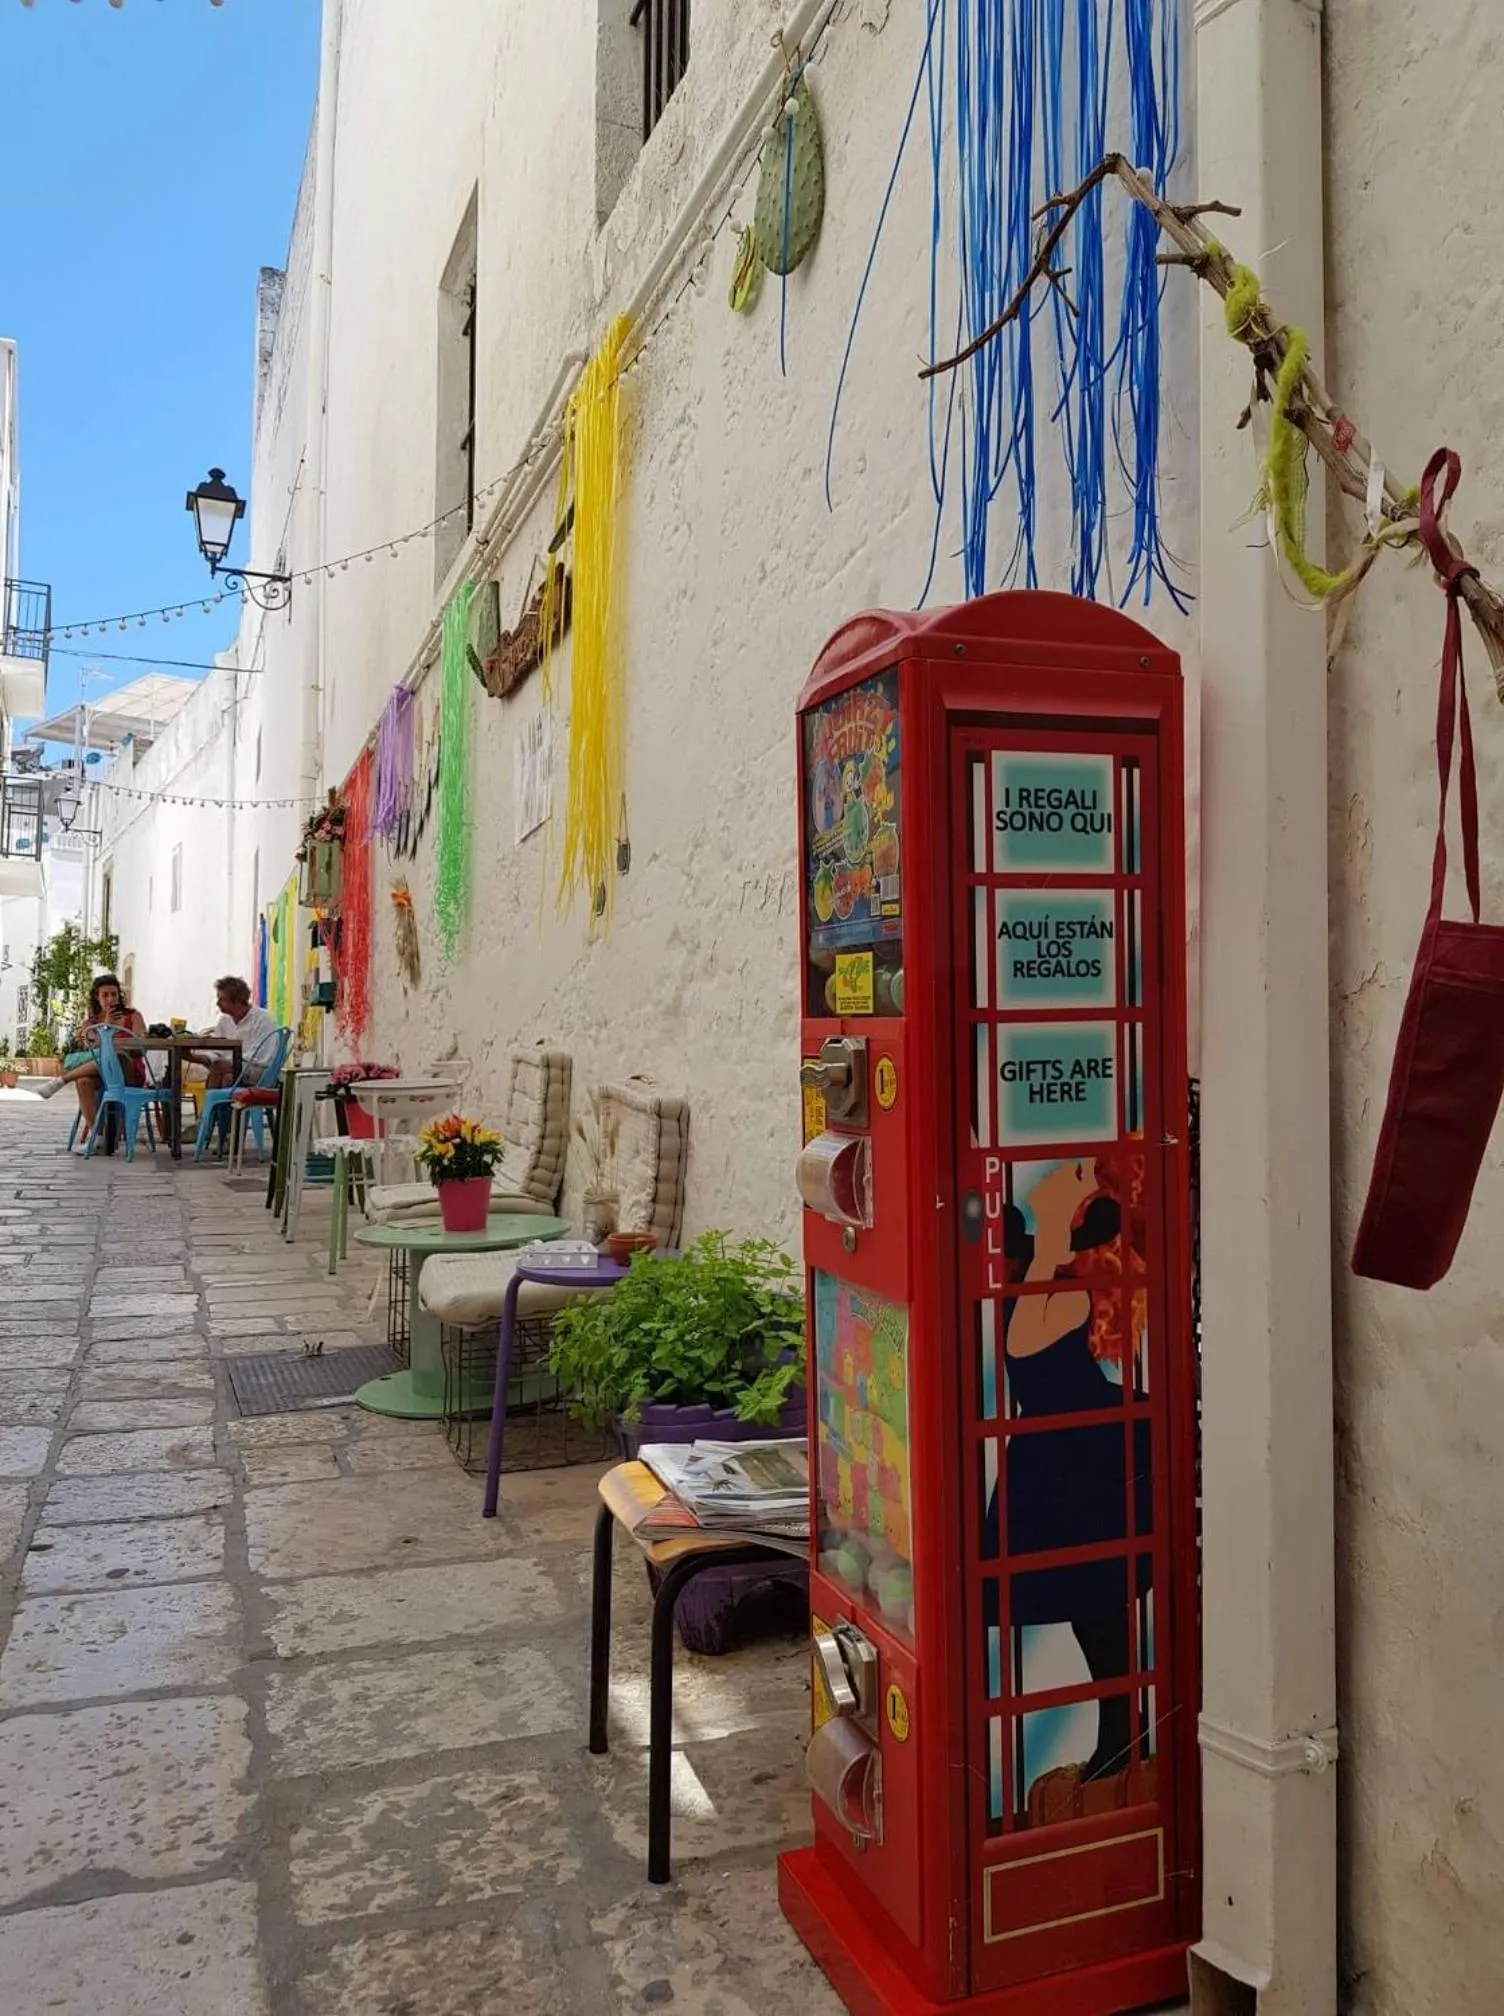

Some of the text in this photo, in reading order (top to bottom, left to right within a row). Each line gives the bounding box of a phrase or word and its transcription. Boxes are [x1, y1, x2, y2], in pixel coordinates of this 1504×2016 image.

[1004, 787, 1097, 811] I REGALI
[995, 810, 1112, 835] SONO QUI
[997, 913, 1114, 941] AQUÍ ESTÁN
[1037, 940, 1072, 959] LOS
[1013, 959, 1102, 978] REGALOS
[1000, 1057, 1113, 1082] GIFTS ARE
[1029, 1081, 1087, 1104] HERE
[985, 1156, 1002, 1289] PULL
